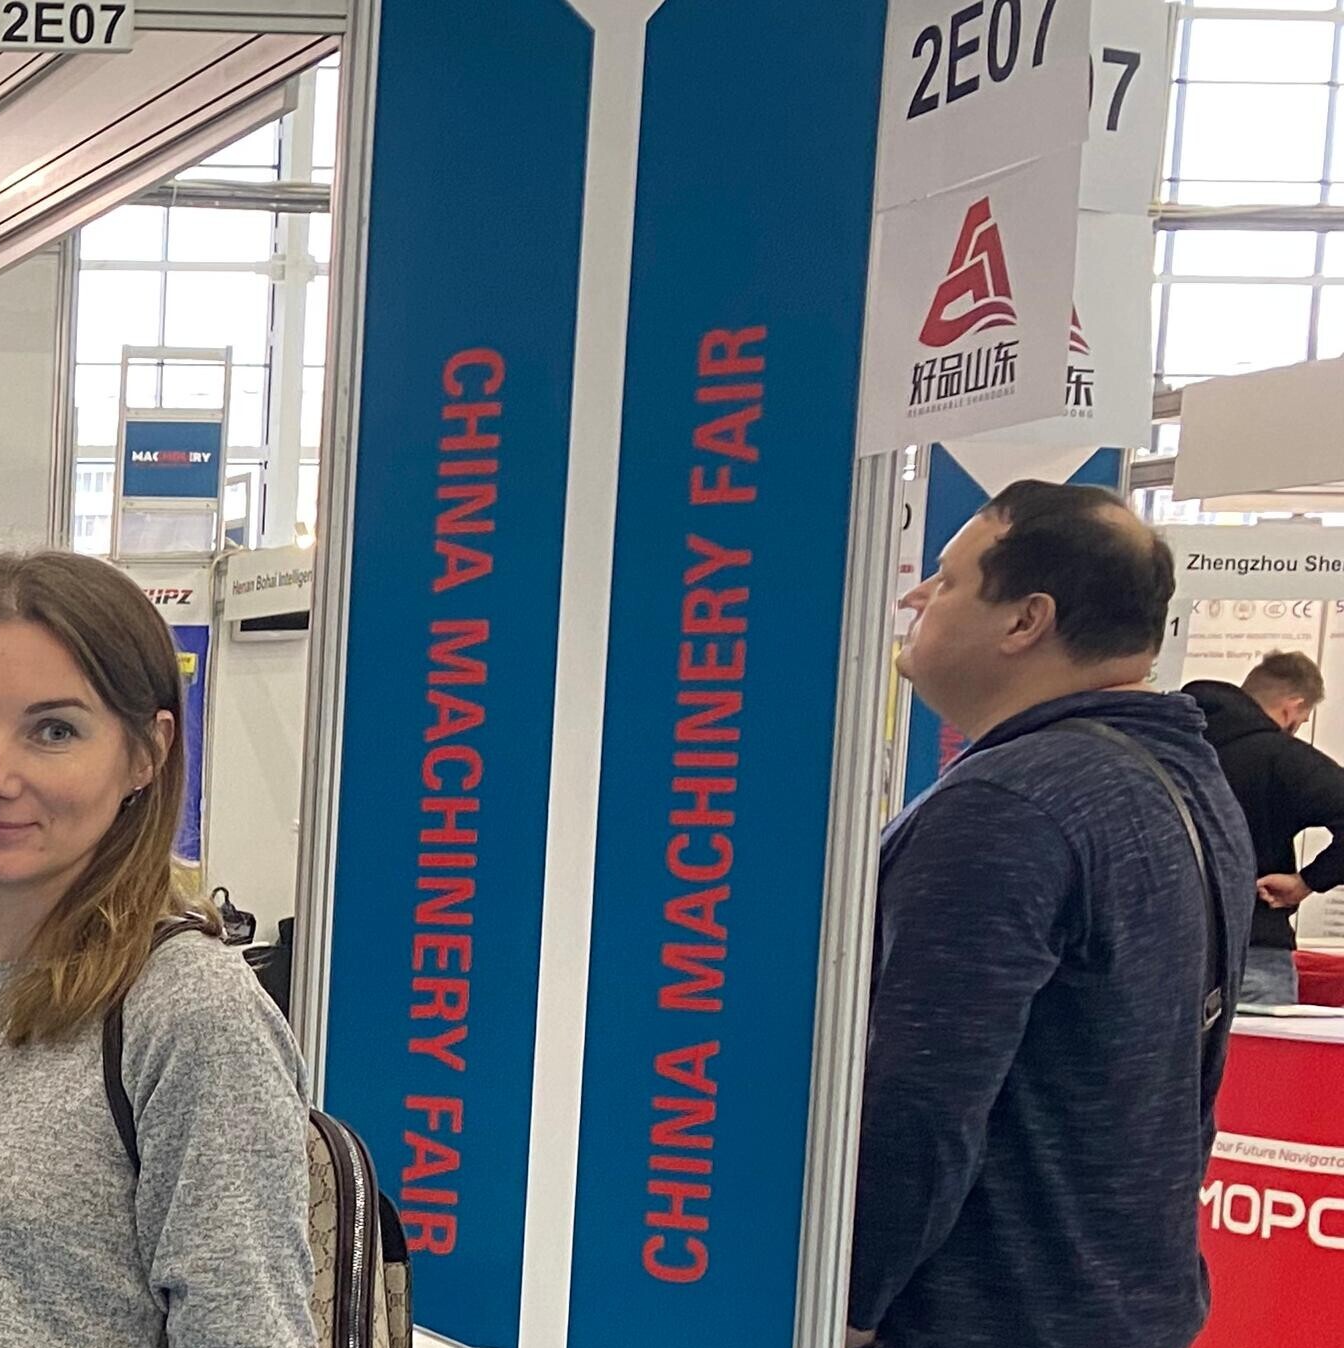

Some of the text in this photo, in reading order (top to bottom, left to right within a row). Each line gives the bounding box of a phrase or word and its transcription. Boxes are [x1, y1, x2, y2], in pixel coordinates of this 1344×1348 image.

[1, 1, 126, 45] 2E07
[907, 0, 1057, 120] 2E07
[909, 340, 1020, 407] 好品山东
[1186, 554, 1344, 575] Zhengzhou She
[399, 346, 506, 1256] CHINA MACHINERY FAIR
[643, 322, 768, 1285] CHINA MACHINERY FAIR
[1235, 1142, 1277, 1159] Future
